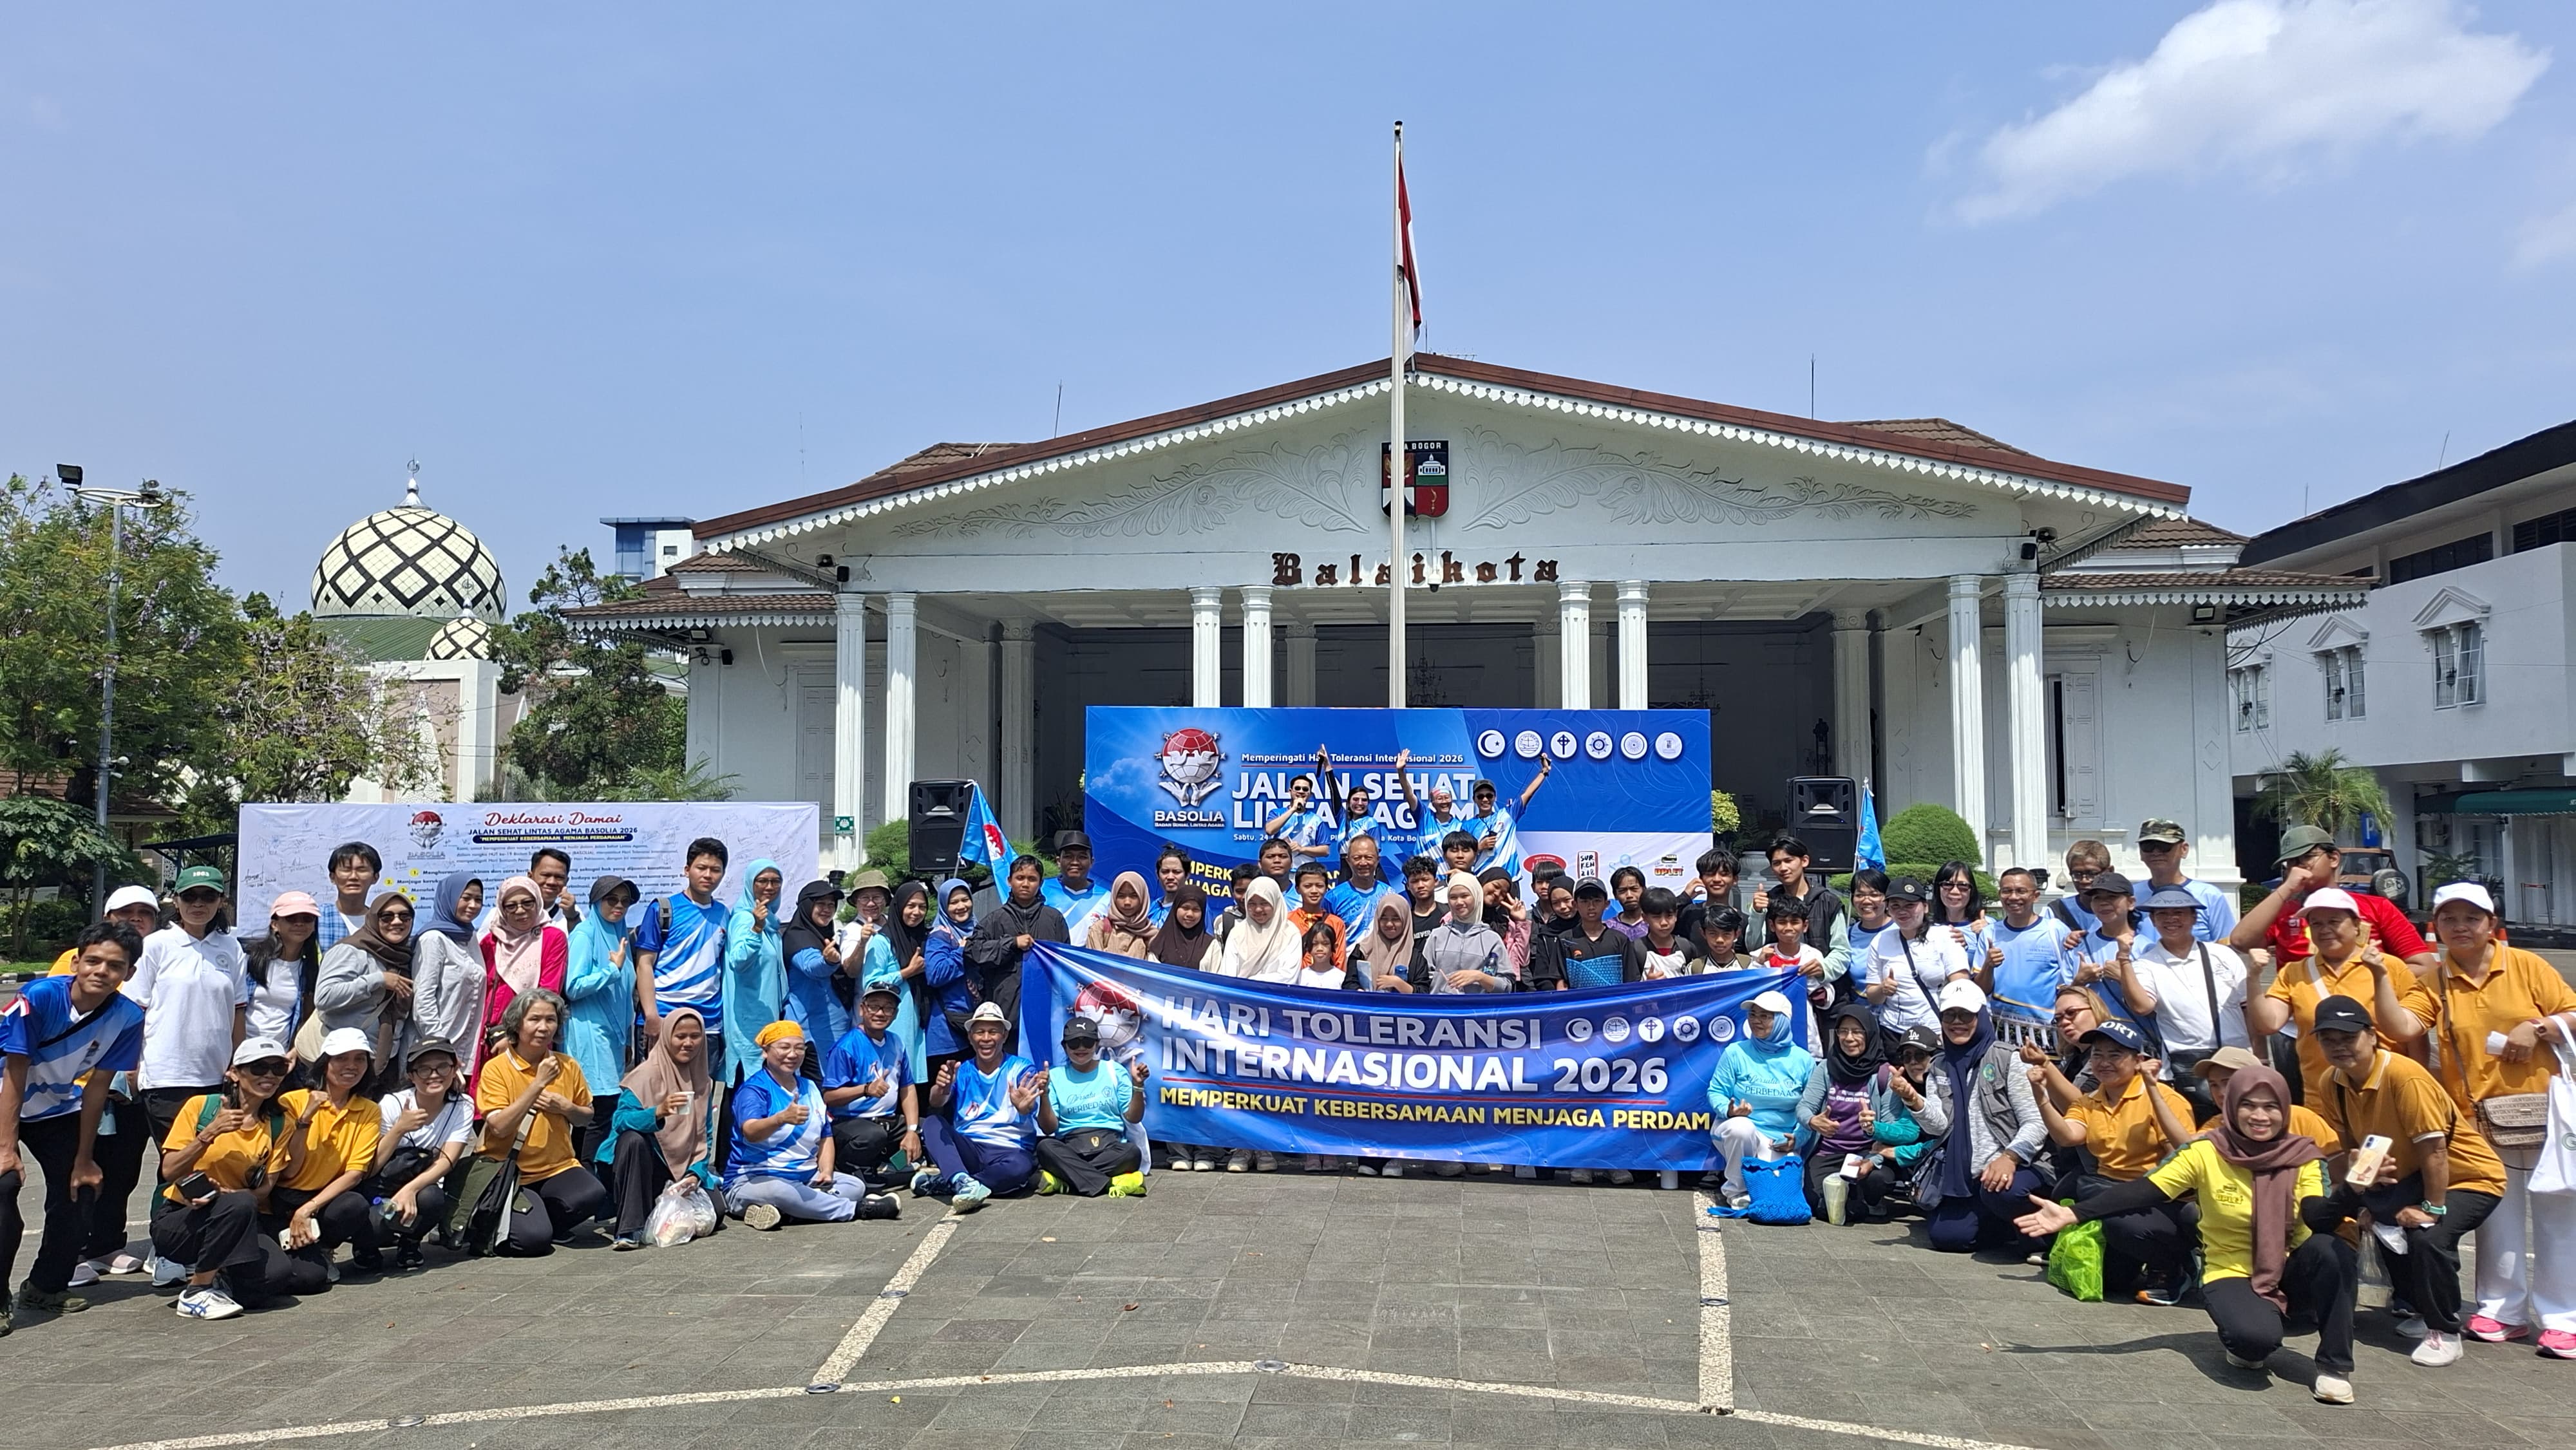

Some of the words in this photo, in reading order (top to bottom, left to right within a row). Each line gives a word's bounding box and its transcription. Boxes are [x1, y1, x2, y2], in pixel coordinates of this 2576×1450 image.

[1272, 551, 1559, 586] Balaikota
[1241, 753, 1305, 764] Memperingati
[1330, 753, 1372, 762] Toleransi
[1375, 754, 1436, 763] Intersional
[1439, 755, 1464, 763] 2026
[1363, 773, 1476, 800] SEHAT
[484, 812, 564, 827] Deklarasi
[568, 811, 623, 826] Damai
[1154, 810, 1226, 822] BASOLIA
[1162, 995, 1270, 1037] HARI
[1282, 1009, 1541, 1050] TOLERANSI
[2101, 1021, 2137, 1040] ORT
[1908, 1030, 1920, 1040] LA
[1162, 1036, 1538, 1092] INTERNASIONAL
[1553, 1057, 1669, 1094] 2026
[1745, 1086, 1797, 1097] PERBEDAAN
[1066, 1097, 1114, 1115] PERBEDAAN
[1160, 1087, 1309, 1115] MEMPERKUAT
[1314, 1098, 1485, 1124] KEBERSAMAAN
[1493, 1107, 1605, 1127] MENJAGA
[1613, 1109, 1710, 1130] PERDAM
